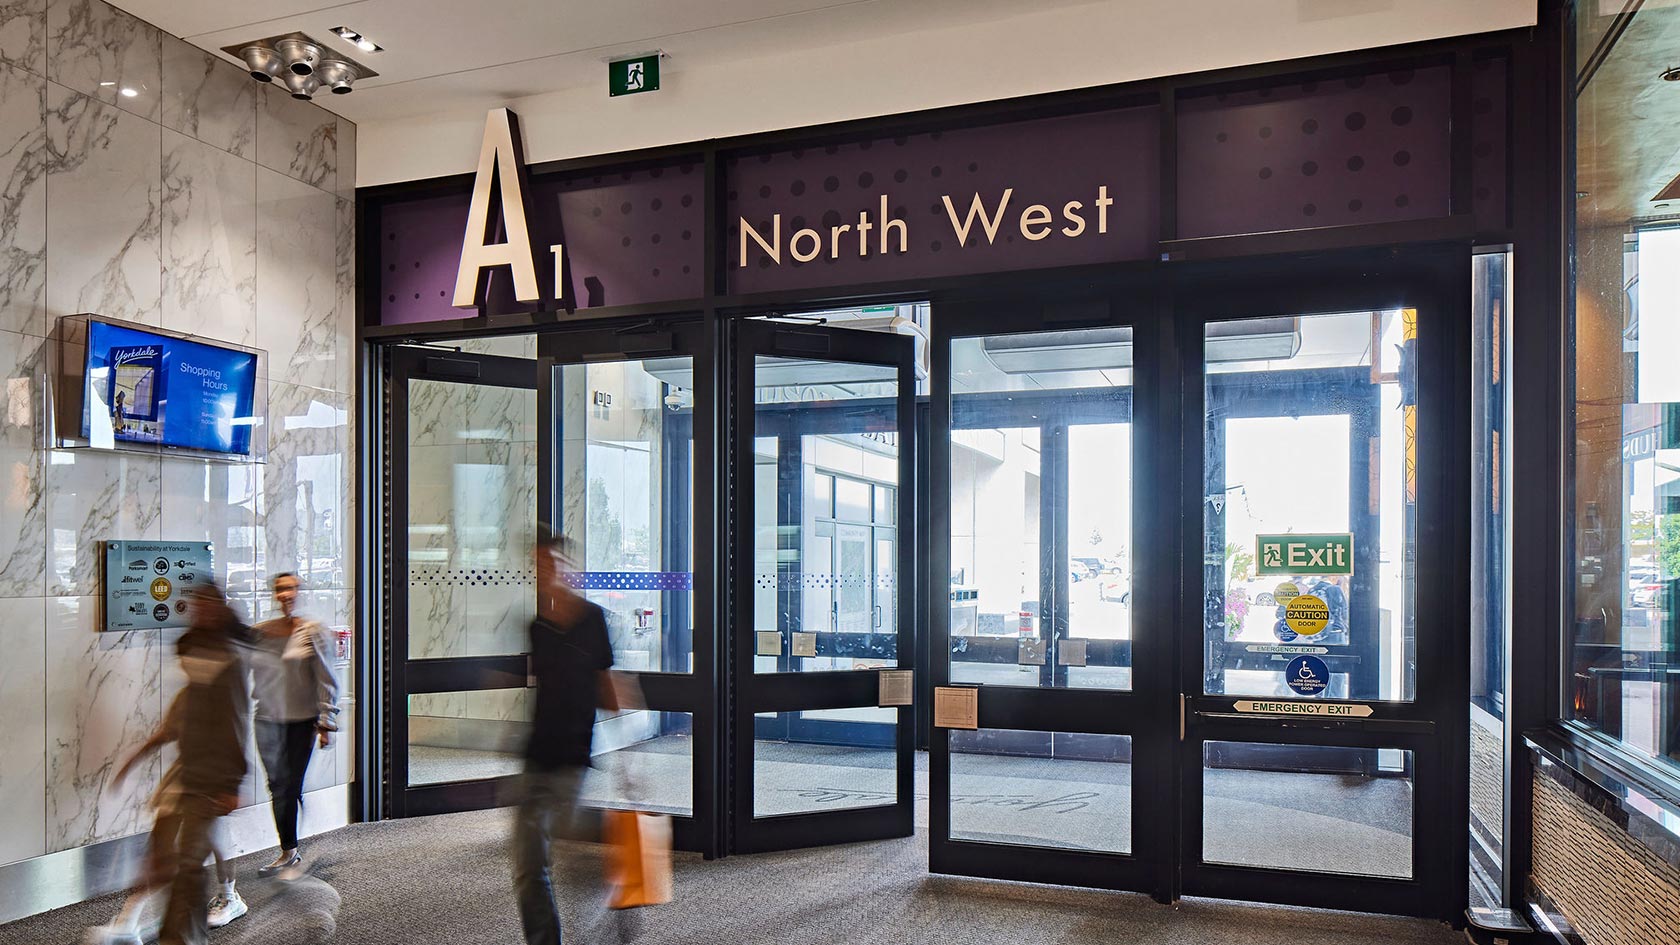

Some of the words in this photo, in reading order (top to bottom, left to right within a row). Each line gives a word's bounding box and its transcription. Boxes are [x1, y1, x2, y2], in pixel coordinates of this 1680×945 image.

[452, 107, 540, 307] A
[550, 244, 563, 299] 1
[740, 194, 908, 267] North
[941, 185, 1113, 248] West
[114, 345, 159, 370] Yorkdale
[180, 362, 221, 379] Shopping
[203, 378, 228, 391] Hours
[128, 545, 162, 553] Sustainability
[1288, 543, 1345, 567] Exit
[154, 585, 168, 593] LEED
[1286, 611, 1328, 619] CAUTION
[1252, 702, 1322, 713] EMERGENCY
[1327, 705, 1353, 715] EXIT
